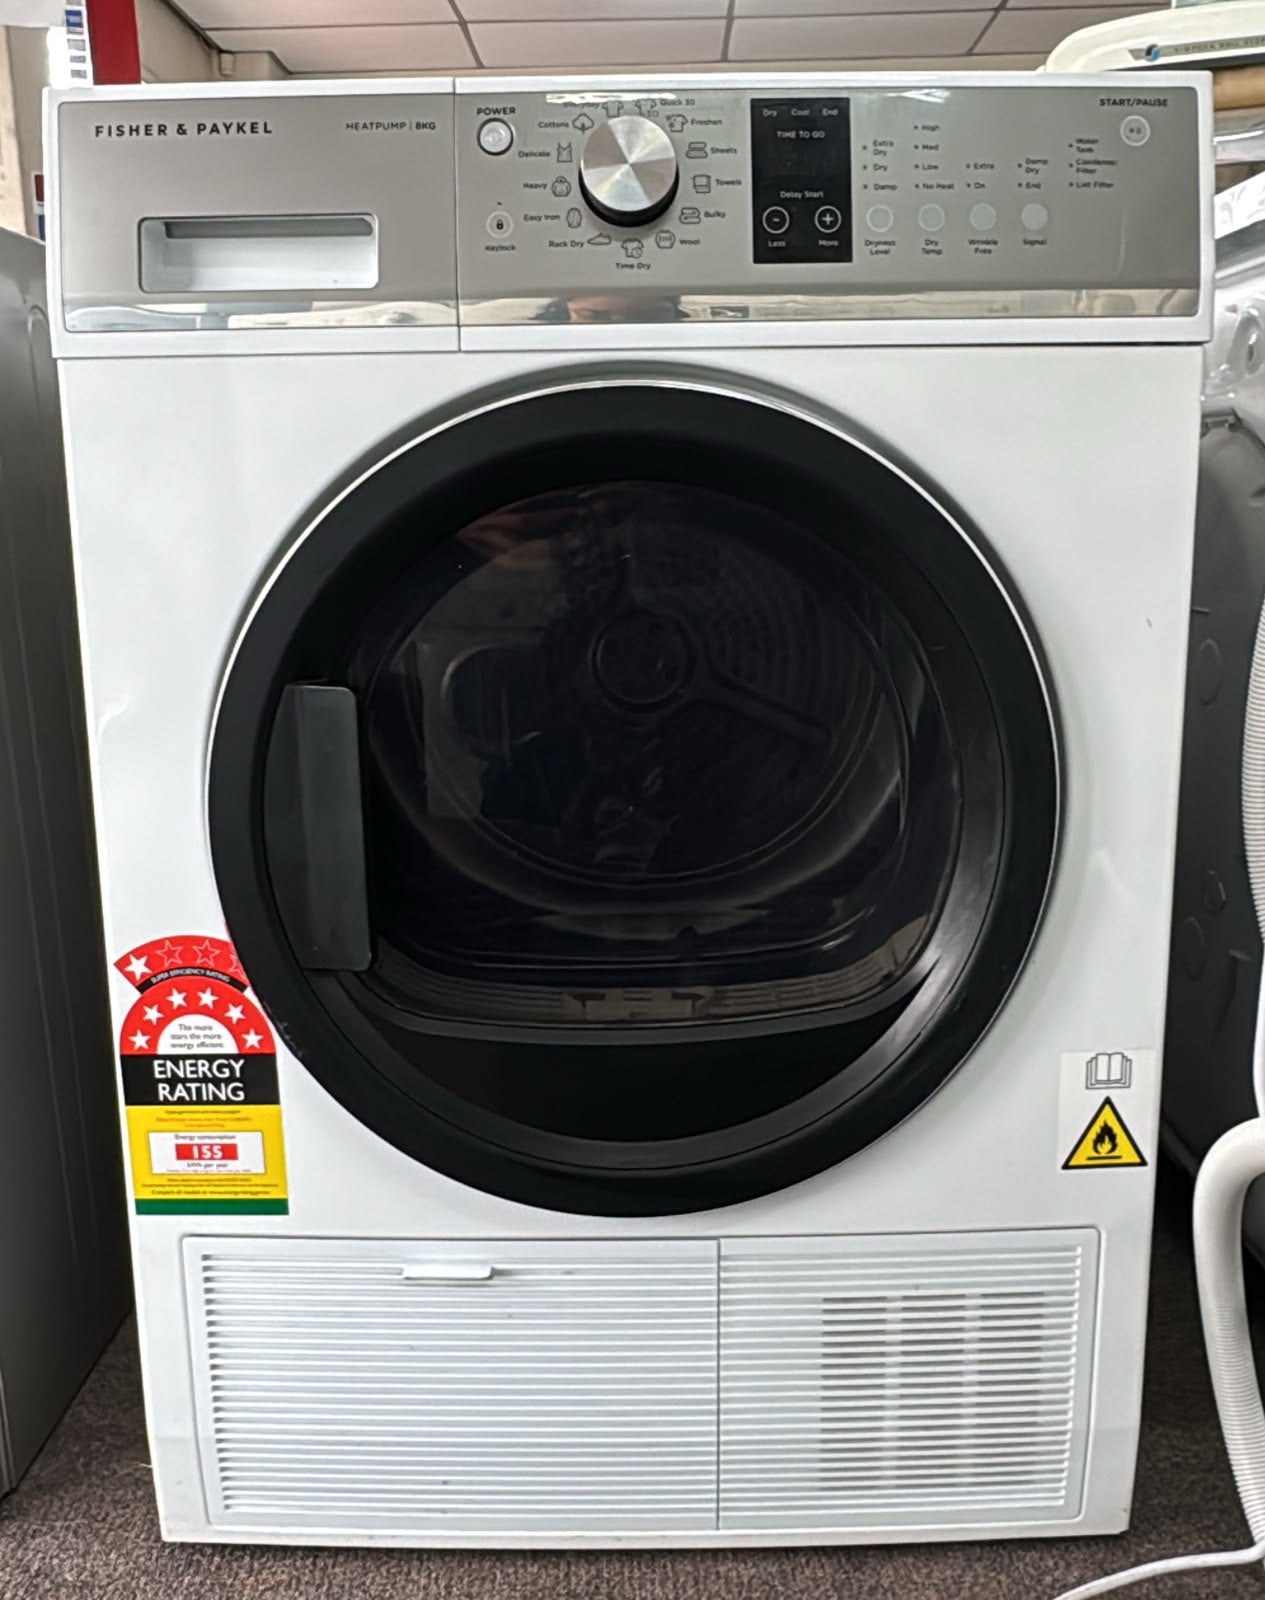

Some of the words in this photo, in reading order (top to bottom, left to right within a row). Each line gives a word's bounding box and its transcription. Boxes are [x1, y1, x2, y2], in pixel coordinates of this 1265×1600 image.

[660, 98, 683, 107] Quick
[1099, 98, 1168, 107] START/PAUSE
[476, 106, 516, 116] POWER
[762, 108, 778, 118] Dry
[791, 108, 810, 117] Cool
[822, 108, 839, 117] End
[345, 121, 407, 132] HEATPUMP
[415, 120, 437, 131] 8KG
[537, 119, 570, 129] Cottons
[690, 117, 723, 127] Freshen
[94, 122, 169, 138] FISHER
[176, 123, 189, 136] &
[197, 121, 274, 136] PAYKEL
[921, 124, 940, 132] High
[776, 130, 796, 139] TIME
[799, 130, 811, 139] TO
[812, 130, 826, 139] GO
[873, 139, 894, 148] Extra
[922, 143, 940, 151] Med
[517, 149, 551, 159] Delicate
[710, 145, 738, 155] Sheets
[873, 148, 887, 157] Dry
[973, 161, 995, 170] Extra
[1025, 157, 1049, 166] Damp
[873, 163, 888, 172] Dry
[922, 163, 939, 171] Low
[1025, 166, 1040, 175] Dry
[522, 181, 548, 191] Heavy
[715, 177, 742, 187] Towels
[922, 182, 935, 190] No
[936, 182, 954, 190] Heat
[973, 181, 986, 190] On
[1025, 181, 1042, 190] End
[1093, 181, 1114, 189] Filter
[873, 183, 898, 192] Damp
[779, 190, 803, 199] Delay
[803, 189, 824, 198] Start
[523, 213, 542, 223] Easy
[543, 212, 561, 222] Iron
[704, 209, 726, 220] Bulky
[548, 239, 568, 249] Rack
[569, 239, 585, 250] Dry
[679, 236, 701, 246] Wool
[767, 239, 786, 248] Less
[818, 238, 839, 247] More
[924, 238, 939, 248] Dry
[968, 238, 999, 247] Wrinkle
[1022, 238, 1048, 248] Signal
[484, 243, 517, 252] Keylock
[869, 247, 891, 256] Level
[921, 247, 943, 256] Temp
[974, 247, 993, 256] Free
[615, 261, 635, 271] Time
[636, 261, 651, 272] Dry
[150, 971, 169, 984] SUPER
[169, 968, 206, 977] EFFICIENCY
[205, 969, 230, 983] RATING
[178, 1023, 192, 1032] The
[193, 1024, 213, 1032] more
[170, 1033, 188, 1041] stars
[189, 1032, 201, 1040] the
[202, 1033, 222, 1041] more
[170, 1042, 194, 1050] energy
[153, 1059, 245, 1079] ENERGY
[158, 1082, 245, 1102] RATING
[174, 1134, 196, 1142] Energy
[197, 1134, 236, 1142] consumption
[192, 1144, 223, 1160] 155
[215, 1162, 229, 1170] year
